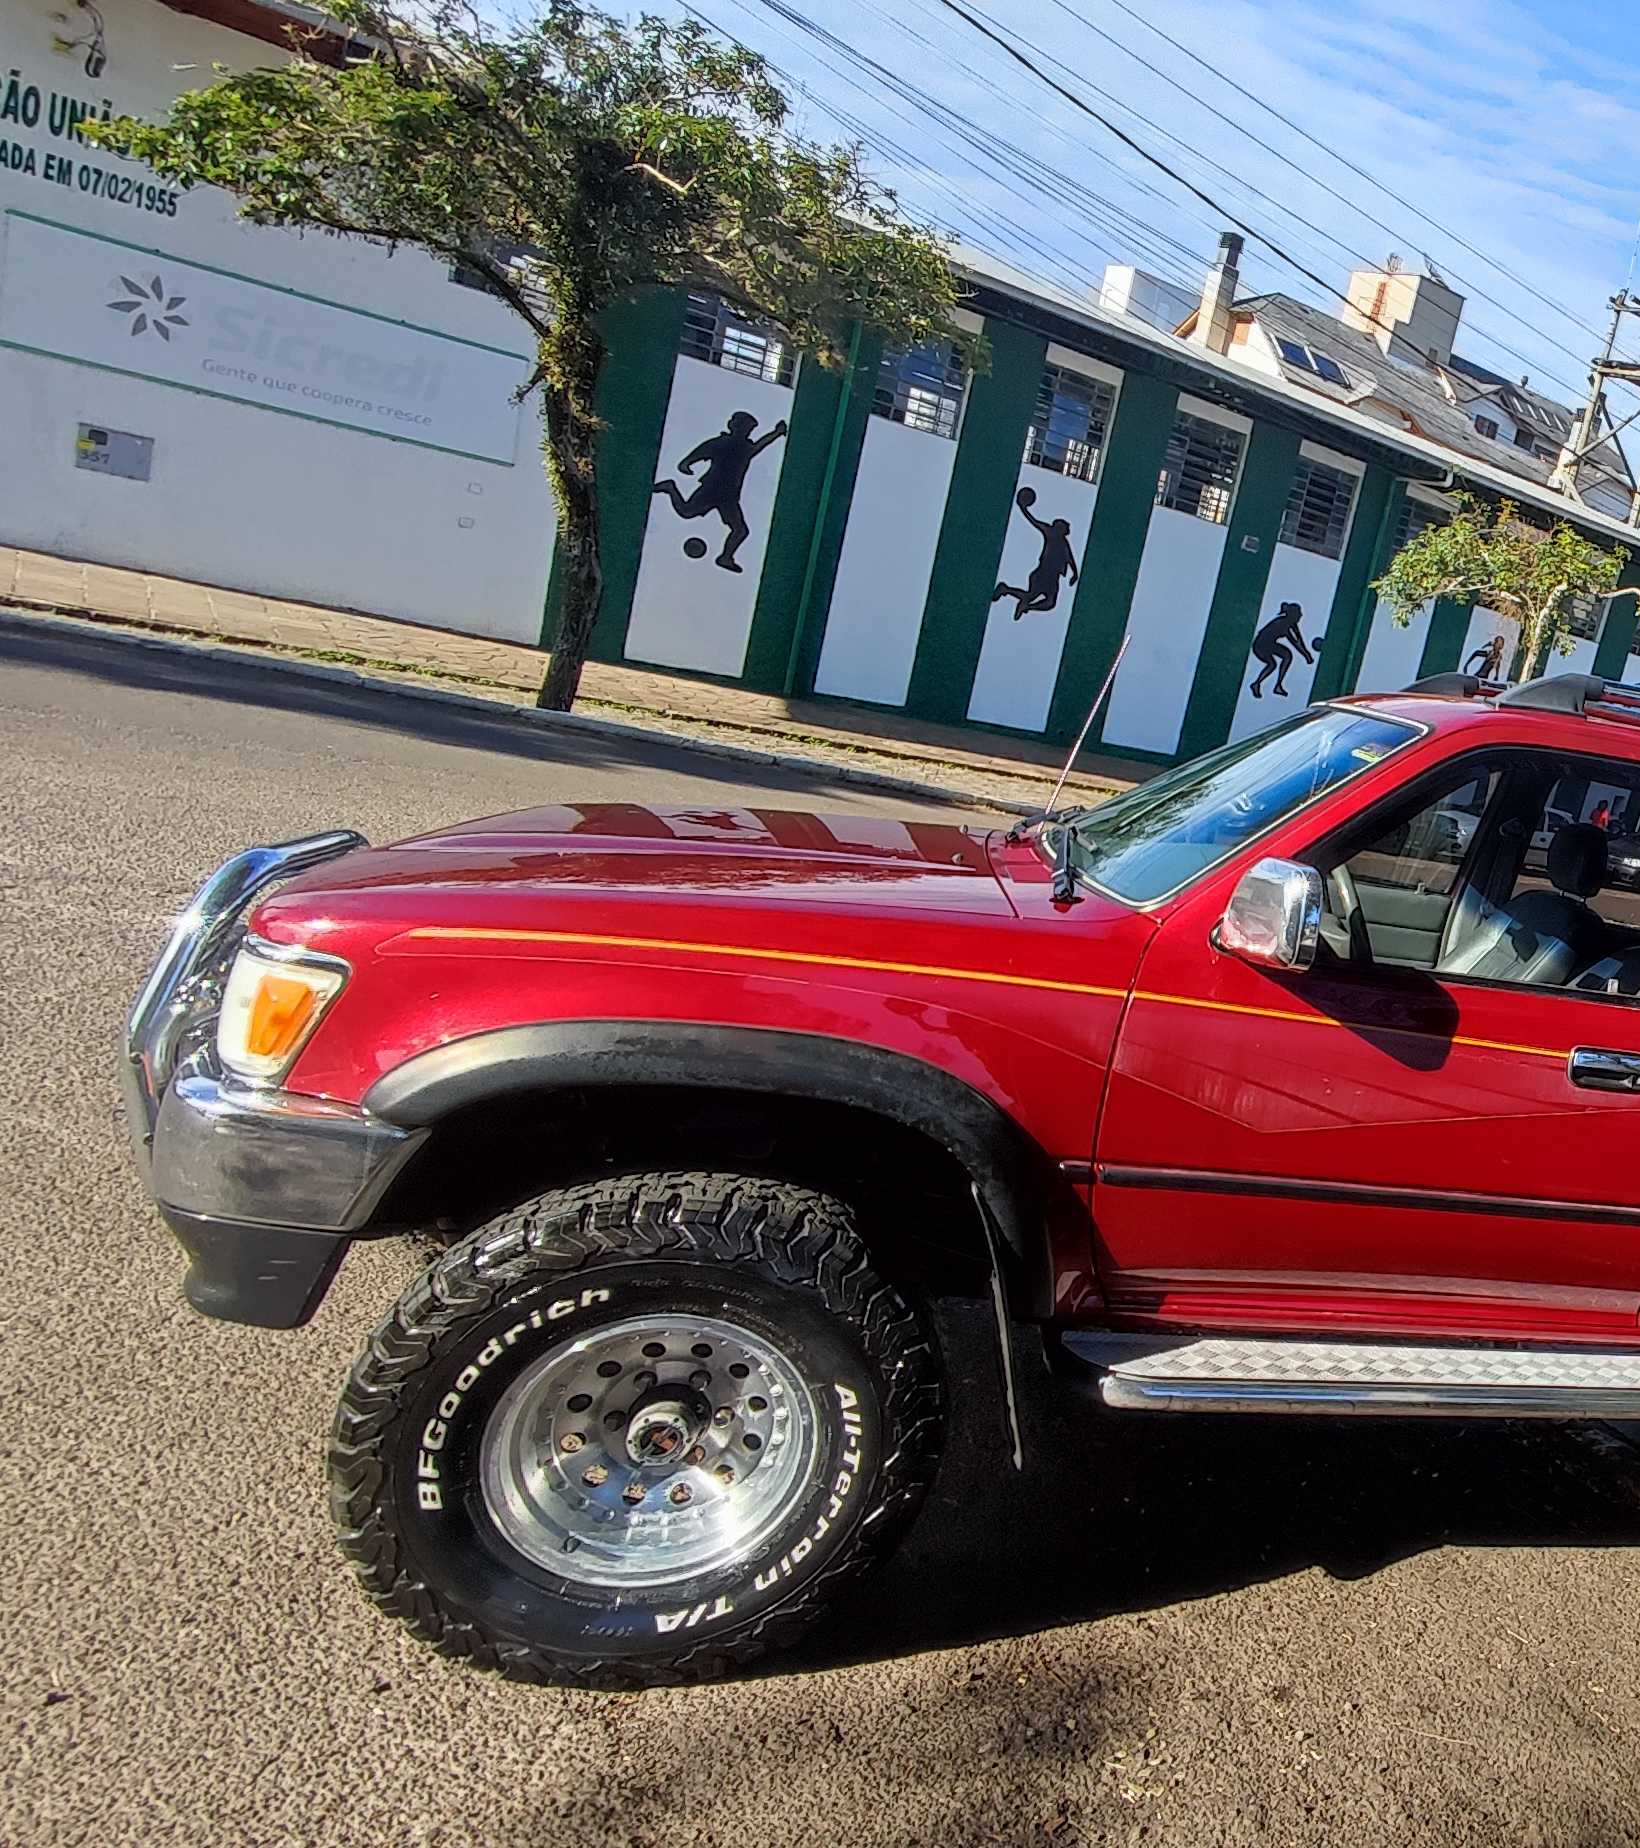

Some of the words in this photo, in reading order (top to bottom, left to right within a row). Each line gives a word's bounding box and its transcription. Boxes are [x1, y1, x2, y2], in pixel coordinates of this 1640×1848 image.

[0, 69, 41, 128] ÃO
[43, 153, 73, 187] EM
[78, 165, 179, 217] 07/02/1955
[208, 305, 448, 404] Sicredi
[202, 358, 257, 384] Gente
[262, 375, 297, 394] que
[301, 385, 373, 412] coopera
[377, 404, 433, 427] cresce
[418, 1288, 610, 1511] BFGoodrich
[753, 1383, 865, 1592] All-Terrain
[654, 1596, 734, 1633] T/A
